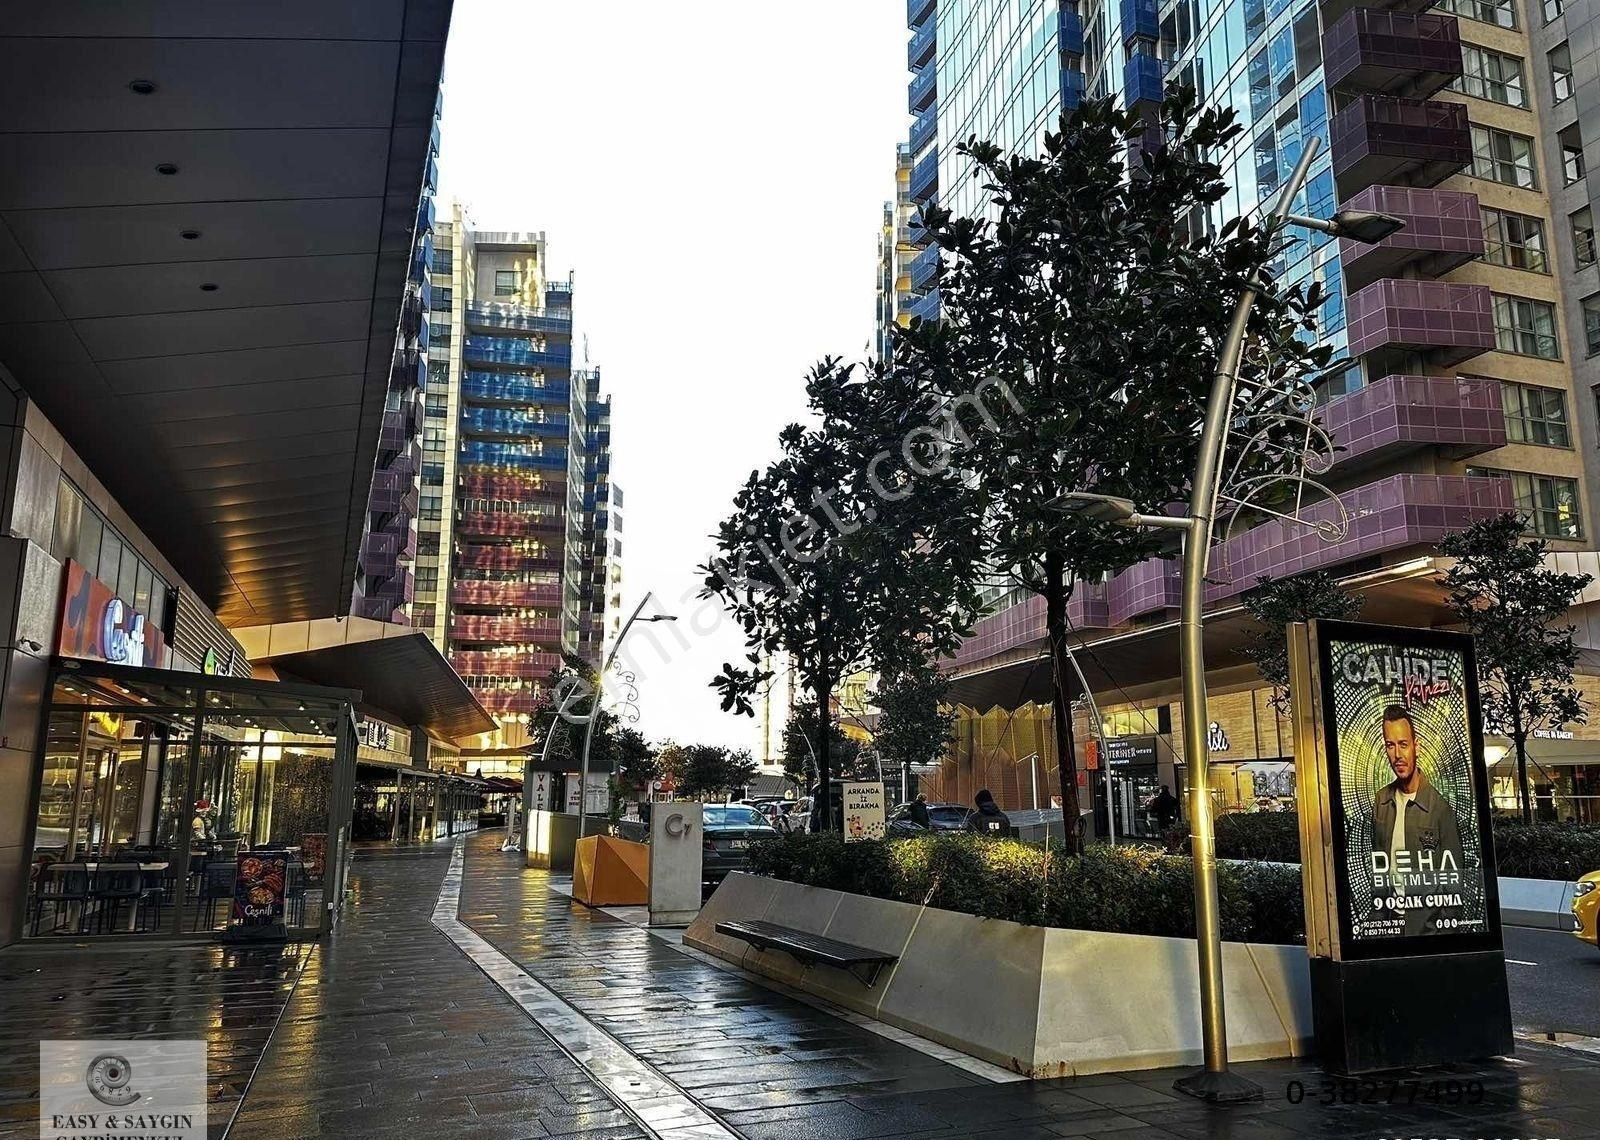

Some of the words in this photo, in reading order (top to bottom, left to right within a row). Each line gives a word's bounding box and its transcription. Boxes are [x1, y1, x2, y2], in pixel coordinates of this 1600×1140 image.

[1371, 849, 1459, 873] DEHA
[1373, 897, 1383, 911] 9
[1385, 895, 1423, 909] OCAK
[1425, 893, 1463, 907] CUMA
